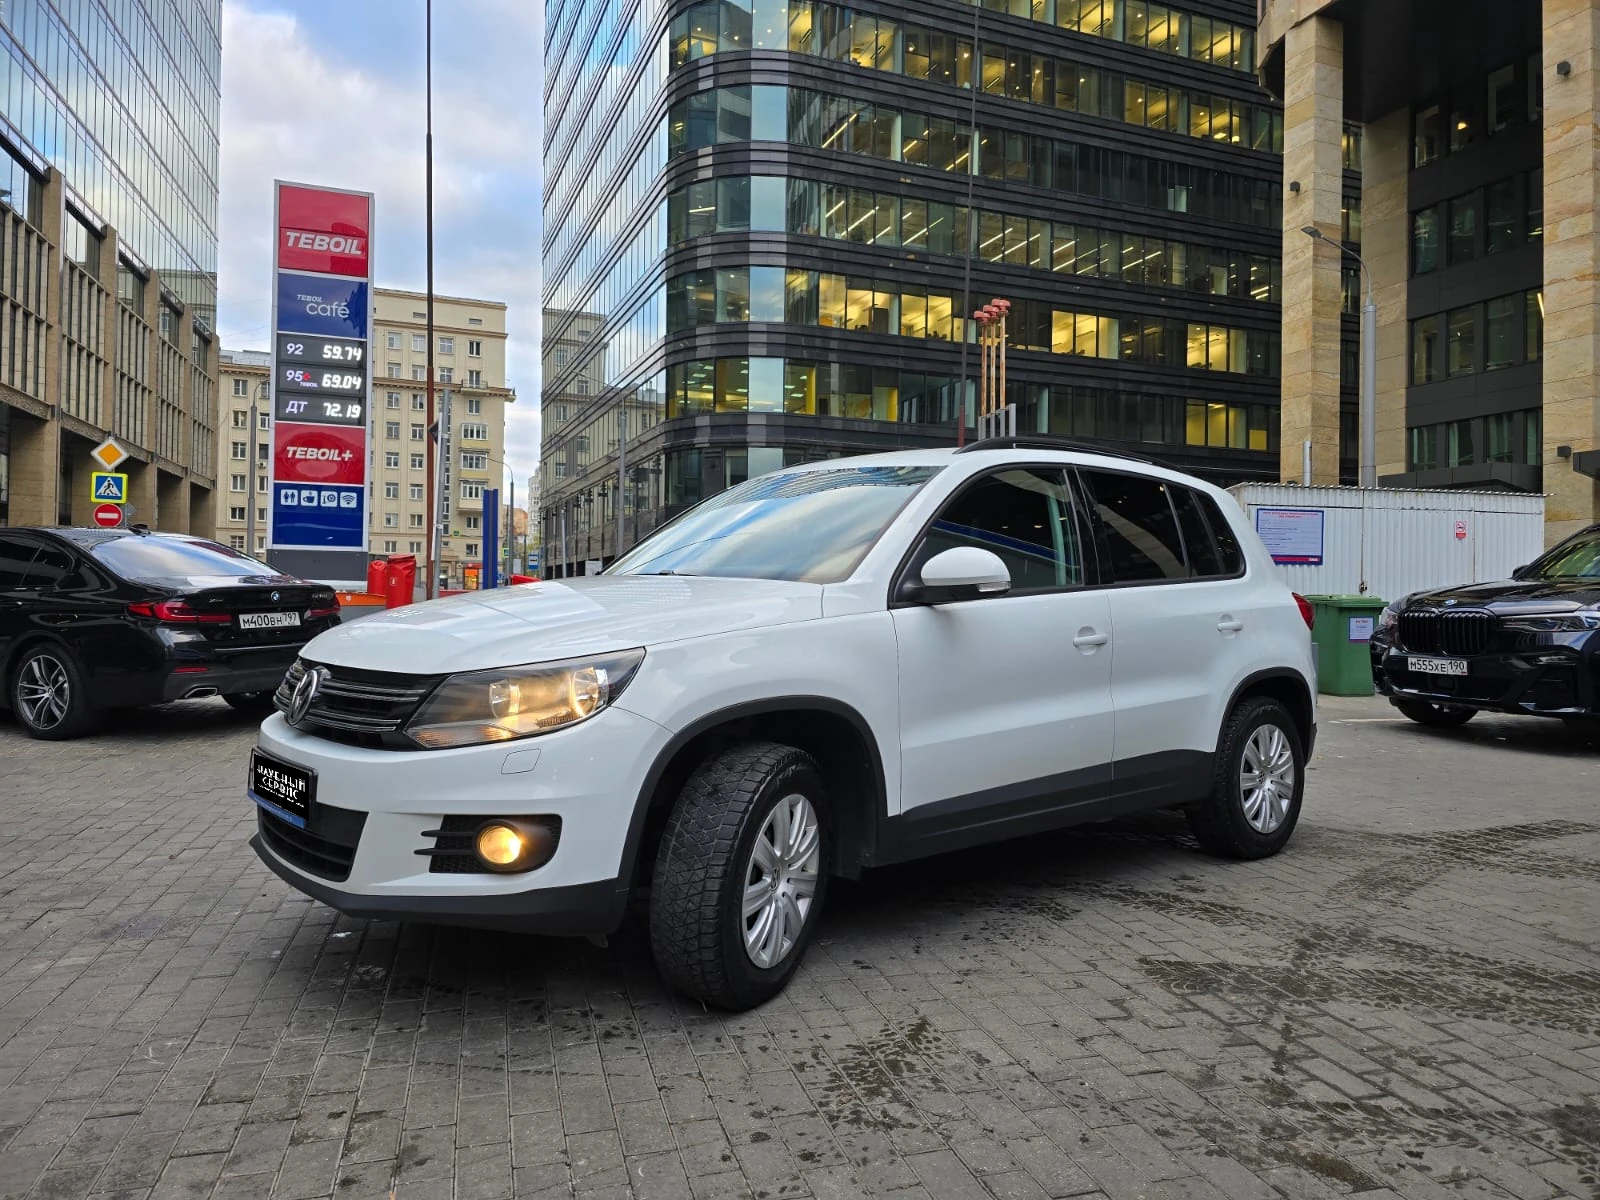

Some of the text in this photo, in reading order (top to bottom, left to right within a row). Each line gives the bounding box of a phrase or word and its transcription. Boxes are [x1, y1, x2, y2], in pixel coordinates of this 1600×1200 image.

[286, 231, 362, 255] TEBOIL
[296, 294, 323, 303] TEBOIL
[306, 301, 350, 319] café
[286, 343, 362, 361] 92 59.74
[286, 369, 362, 390] 95 69.04
[285, 400, 362, 418] ДТ 72.19
[286, 446, 353, 462] TEBOIL+
